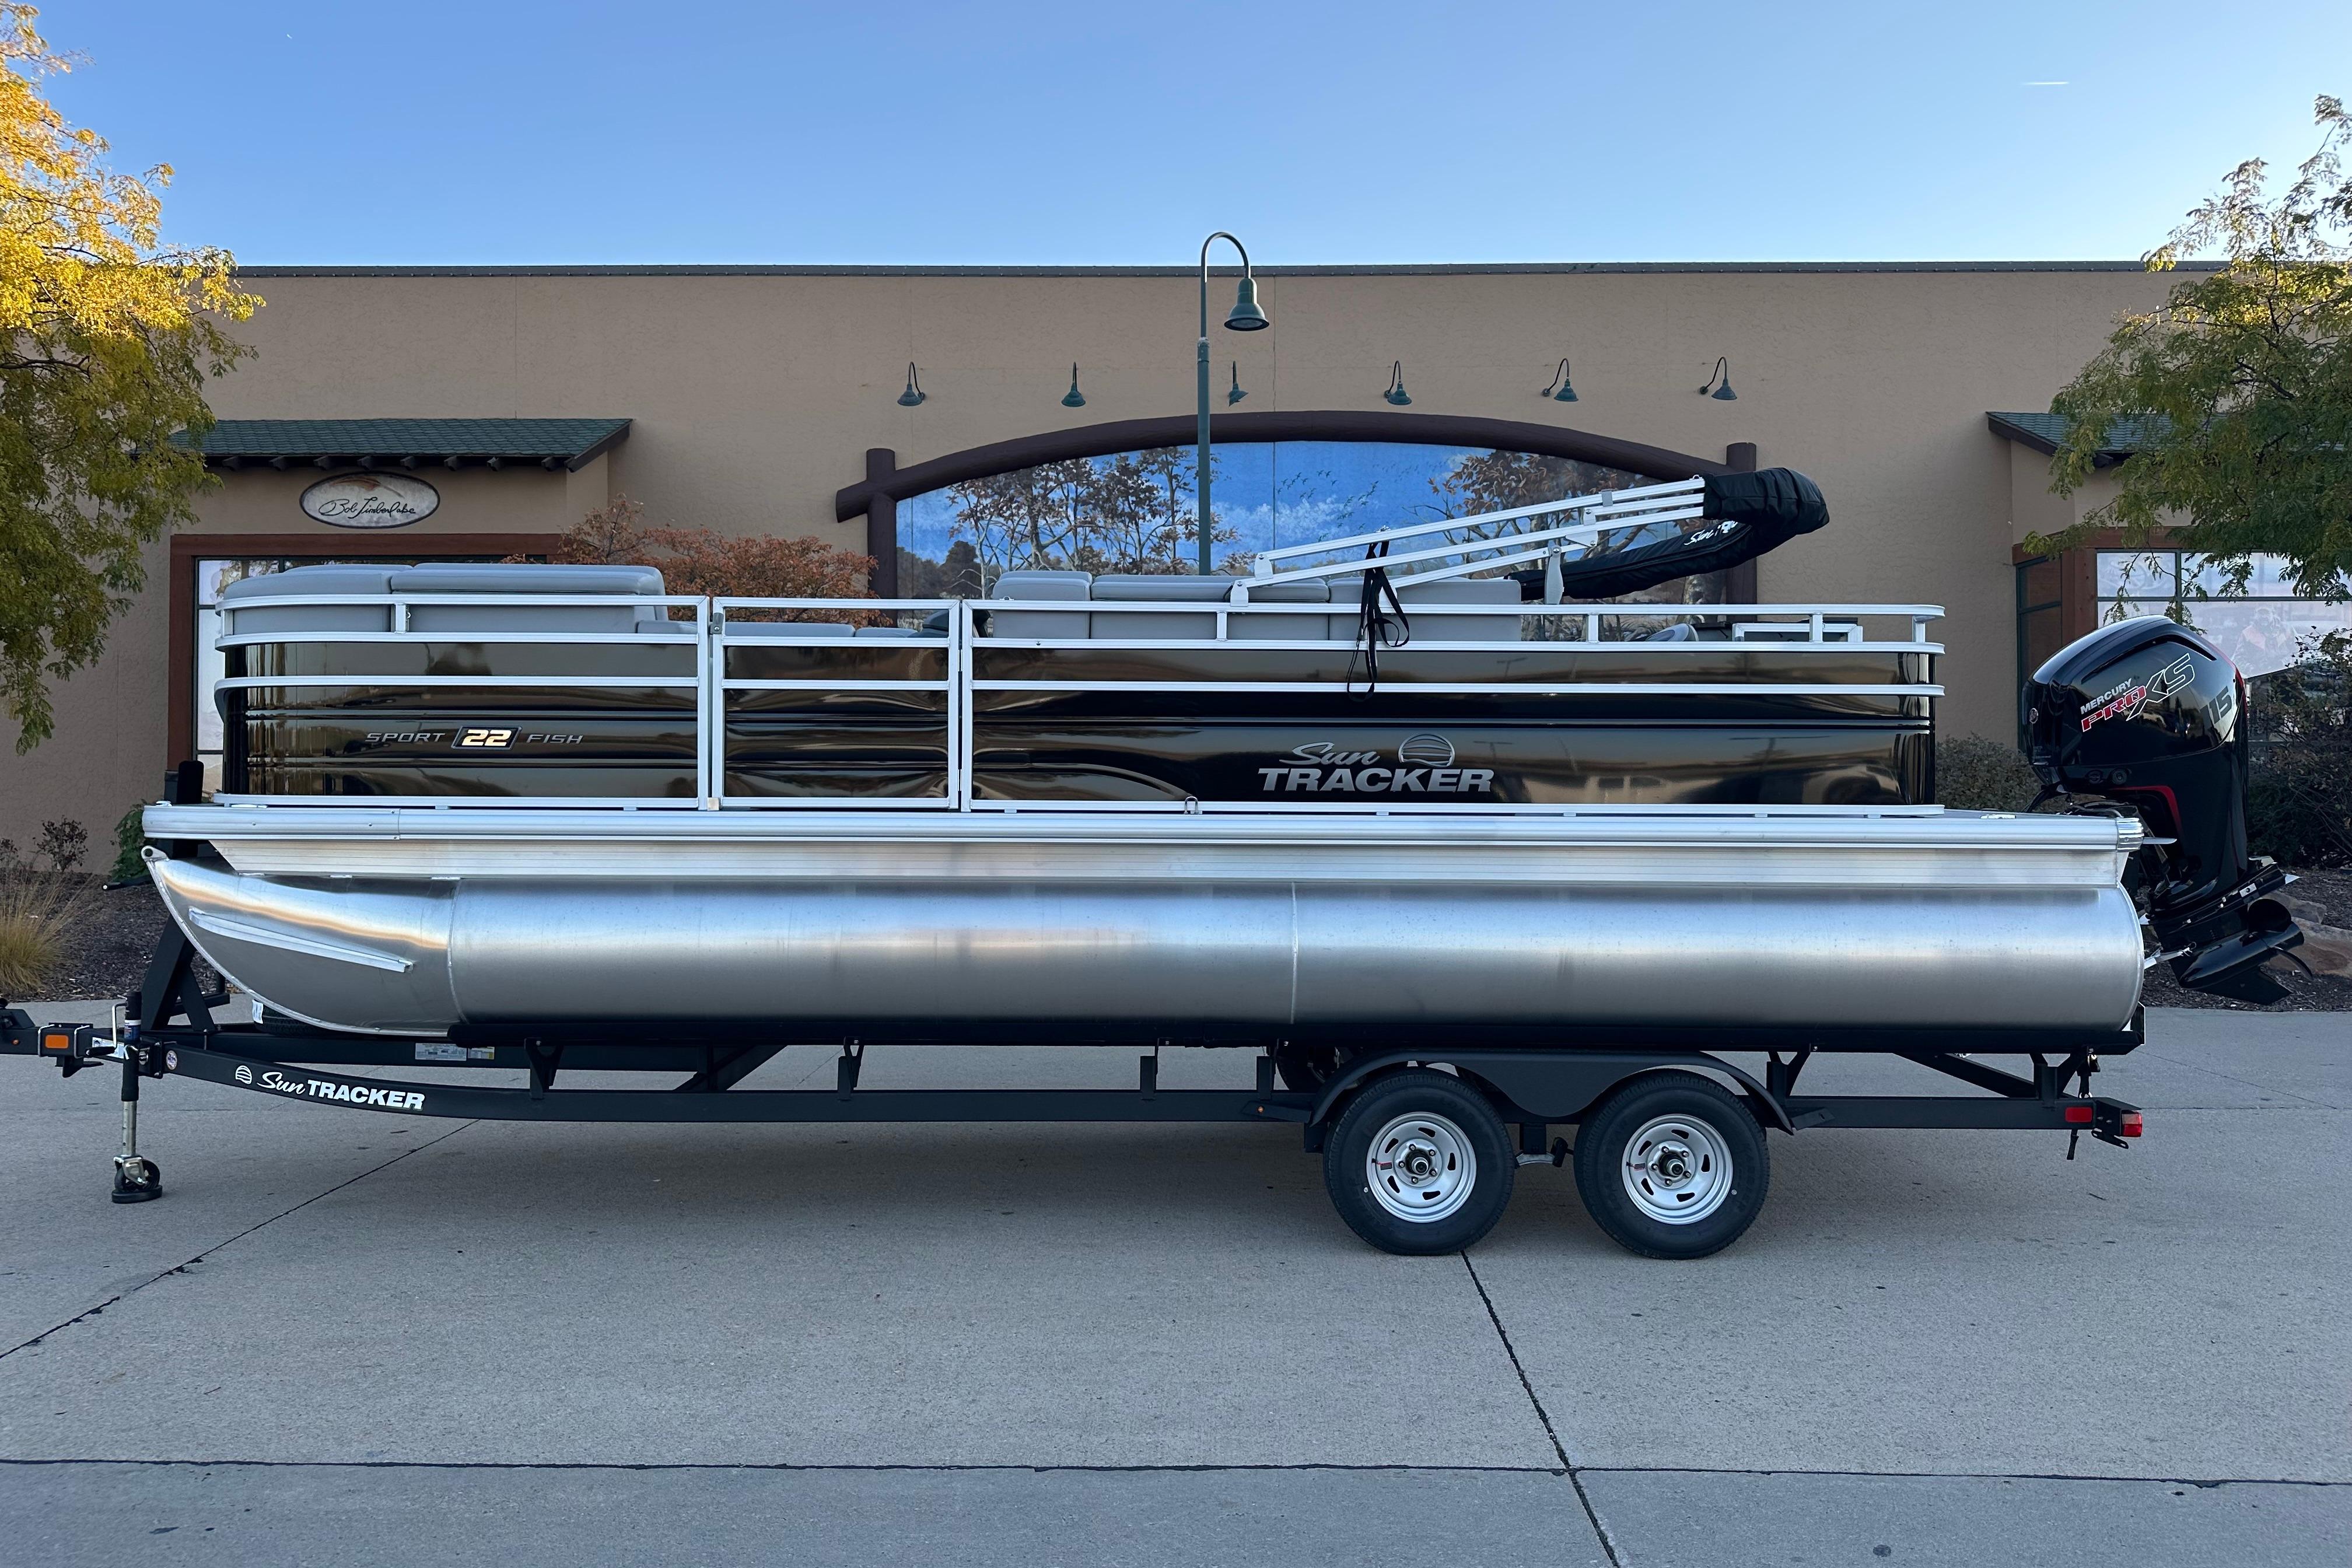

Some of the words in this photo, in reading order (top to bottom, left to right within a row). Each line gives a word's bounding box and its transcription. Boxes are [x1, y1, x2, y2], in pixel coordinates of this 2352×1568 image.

[318, 499, 358, 516] Bob
[2080, 678, 2132, 715] MERCURY
[2200, 686, 2232, 729] 115
[365, 732, 446, 743] SPORT
[461, 729, 512, 746] 22
[526, 734, 583, 744] FISH
[1279, 741, 1380, 765] Sun
[1258, 768, 1494, 792] TRACKER
[257, 1071, 306, 1095] Sun
[307, 1079, 425, 1110] TRACKER
